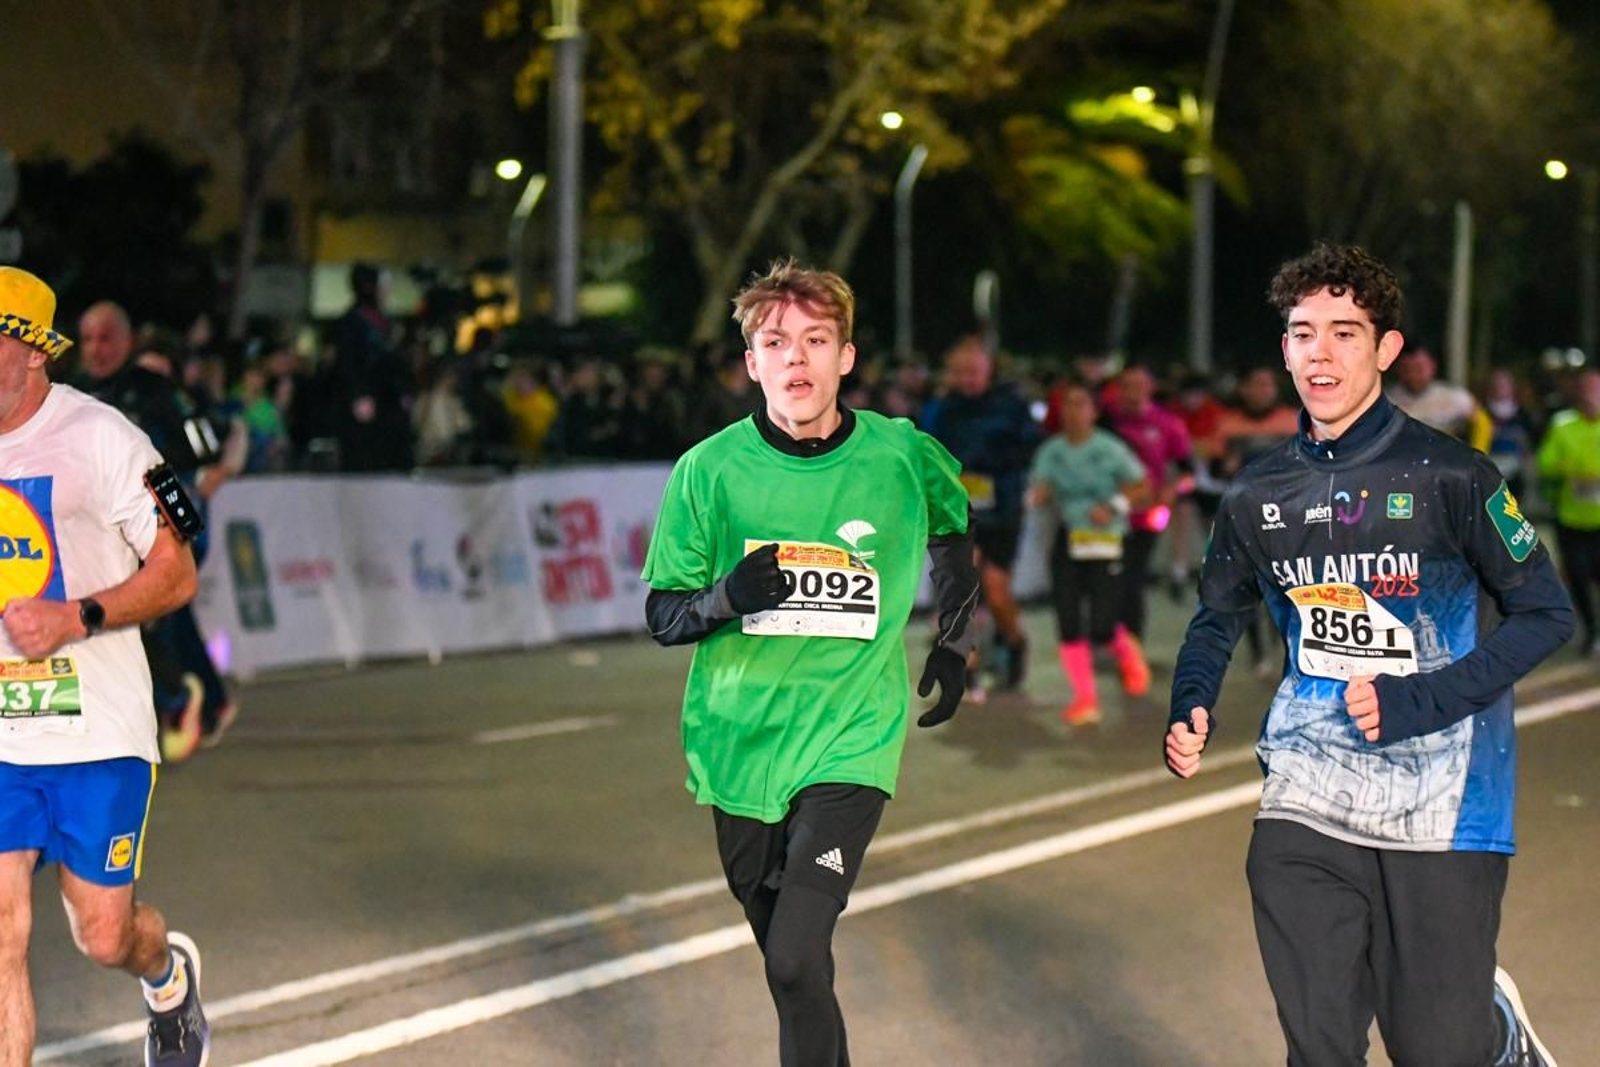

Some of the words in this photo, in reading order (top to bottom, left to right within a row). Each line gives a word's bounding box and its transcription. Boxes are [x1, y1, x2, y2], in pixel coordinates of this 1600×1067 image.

[1271, 556, 1315, 587] SAN
[1322, 544, 1419, 584] ANTÓN
[1371, 573, 1421, 598] 2025
[0, 680, 58, 710] 37
